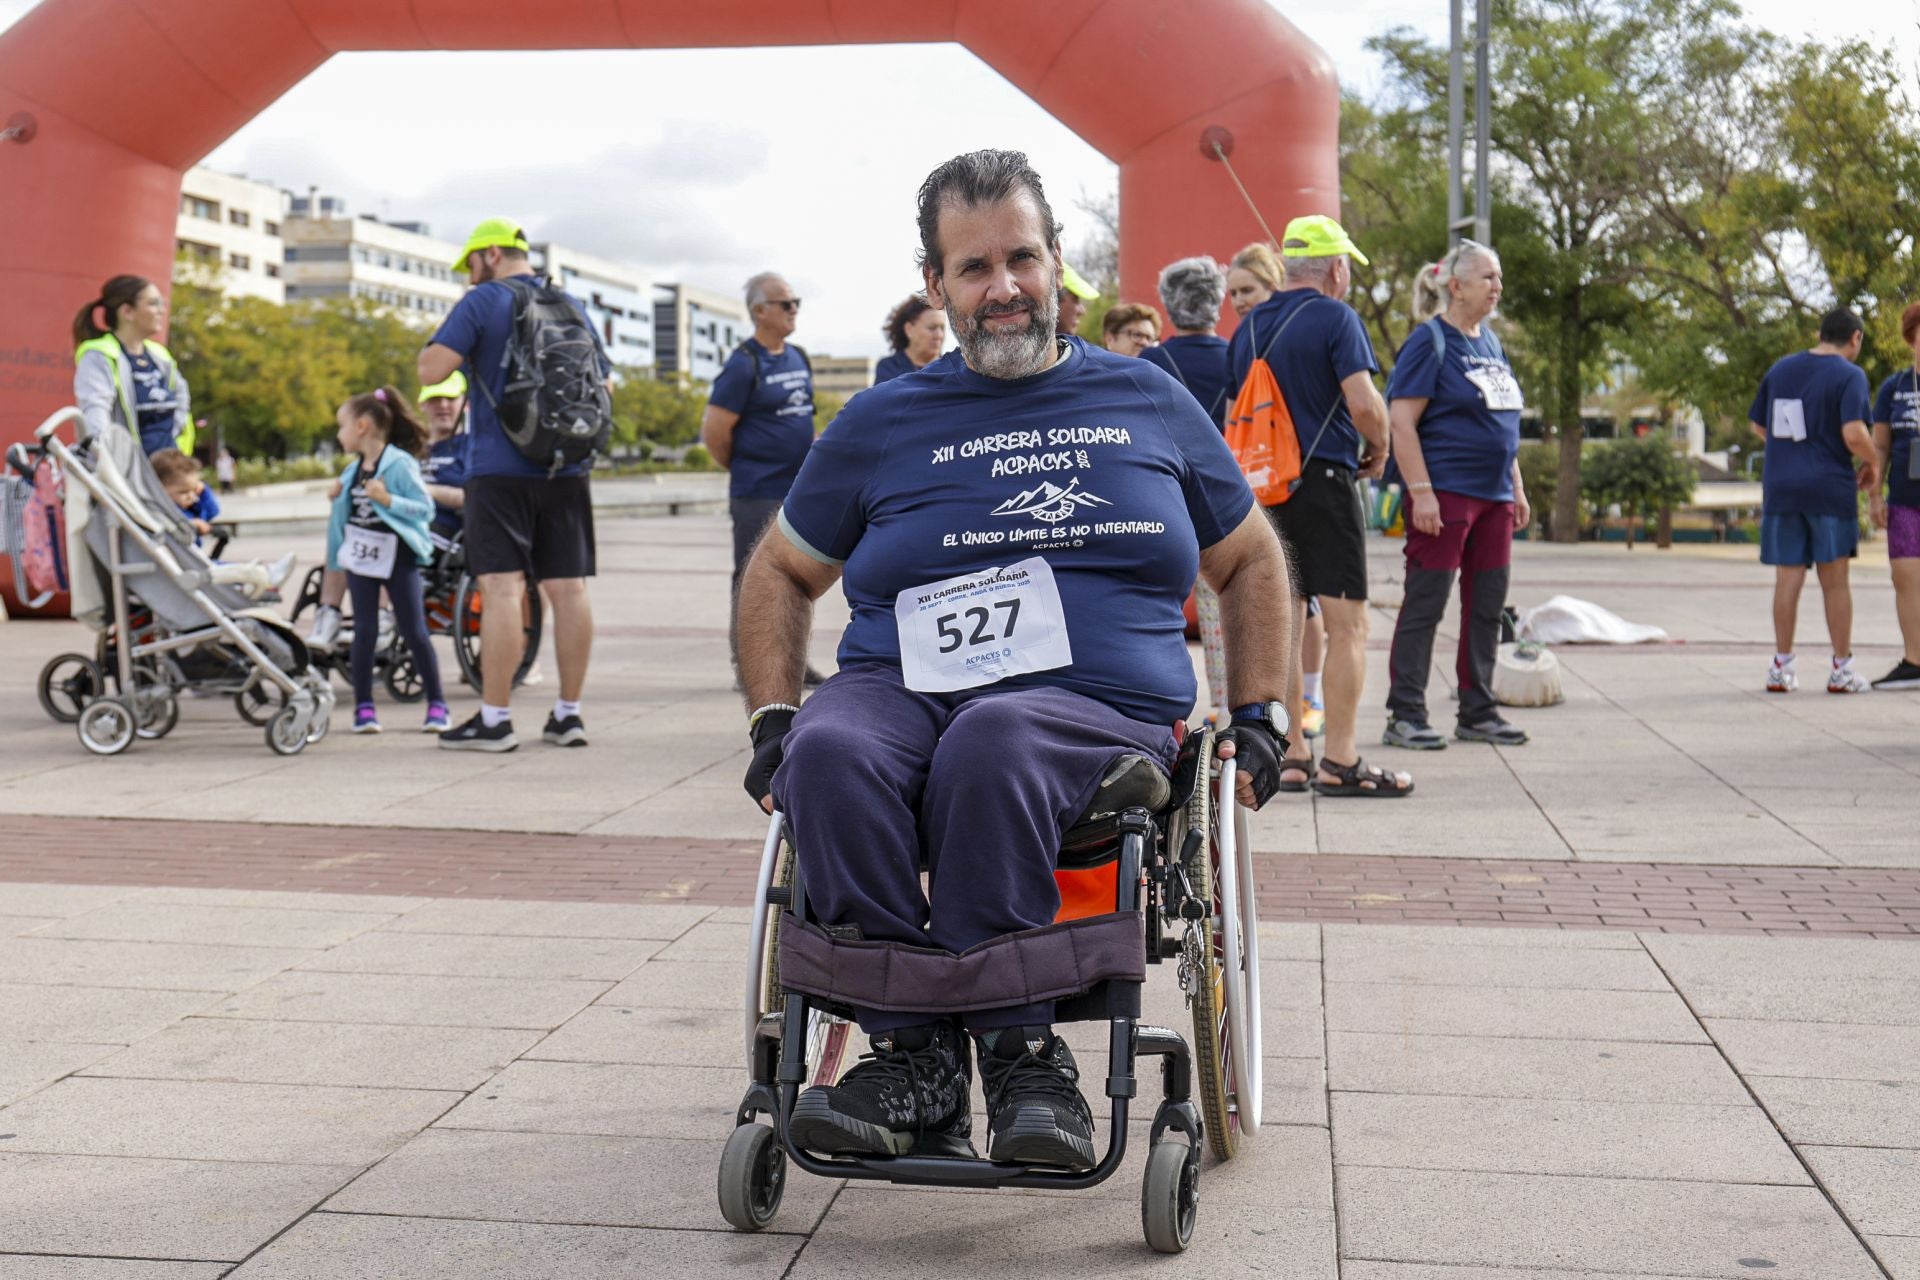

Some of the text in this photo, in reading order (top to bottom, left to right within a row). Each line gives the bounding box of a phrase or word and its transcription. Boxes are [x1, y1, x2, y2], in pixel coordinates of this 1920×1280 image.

[931, 426, 1131, 465] XII CARRERA SOLIDARIA
[991, 449, 1091, 478] ACPACYS 2025
[943, 521, 1165, 547] EL ÚNICO LÍMITE ES NO INTENTARLO
[1032, 542, 1071, 550] ACPACYS
[917, 570, 1029, 604] XII CARRERA SOLIDARIA
[936, 598, 1021, 654] 527
[966, 650, 1001, 665] ACPACYS
